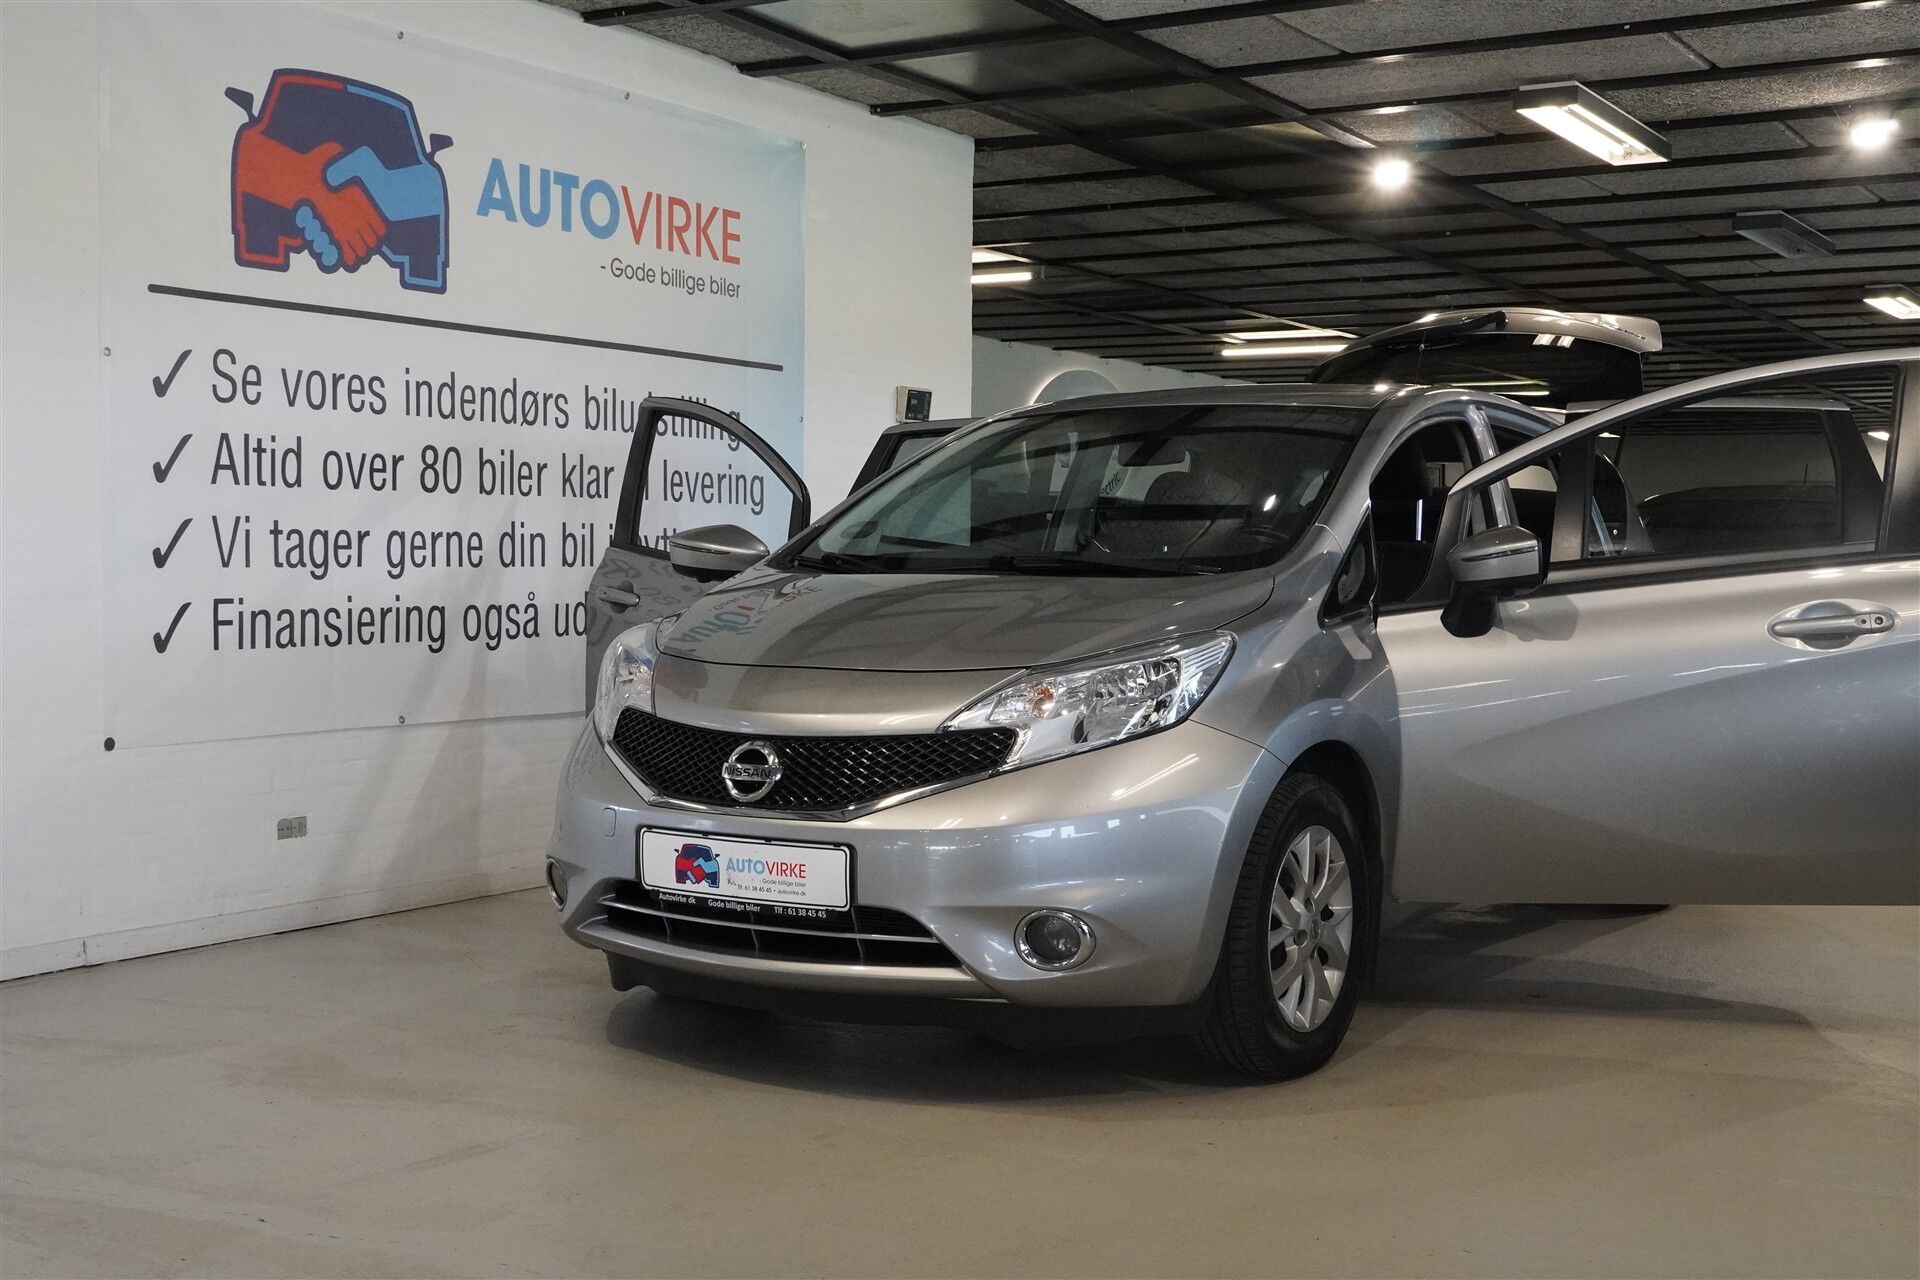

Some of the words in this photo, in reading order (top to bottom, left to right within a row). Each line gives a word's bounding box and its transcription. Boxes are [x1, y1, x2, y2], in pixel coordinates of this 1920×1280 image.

[476, 157, 741, 266] AUTOVIRKE
[610, 257, 656, 284] Gode
[660, 266, 706, 296] billige
[709, 275, 741, 298] biler
[211, 348, 262, 406] Se
[281, 367, 387, 416] vores
[405, 367, 570, 430] indendørs
[211, 432, 302, 489] Altid
[323, 450, 405, 492] over
[419, 444, 462, 495] 80
[478, 446, 548, 498] biler
[561, 452, 615, 499] klar
[663, 458, 765, 516] levering
[212, 515, 251, 568] Vi
[269, 519, 371, 581] tager
[386, 529, 484, 580] gerne
[498, 520, 546, 569] din
[561, 521, 594, 568] bil
[212, 594, 446, 654] Finansiering
[462, 591, 541, 652] også
[554, 591, 588, 638] ud
[724, 765, 771, 778] NISSAN
[726, 858, 806, 878] AUTOVIRKE
[778, 879, 794, 887] billige
[659, 892, 687, 903] Autovirke
[707, 899, 725, 908] Gode
[725, 901, 744, 911] billige
[746, 904, 760, 912] biler
[788, 907, 796, 916] 61
[798, 908, 806, 917] 38
[808, 909, 816, 917] 45
[818, 910, 827, 919] 45
